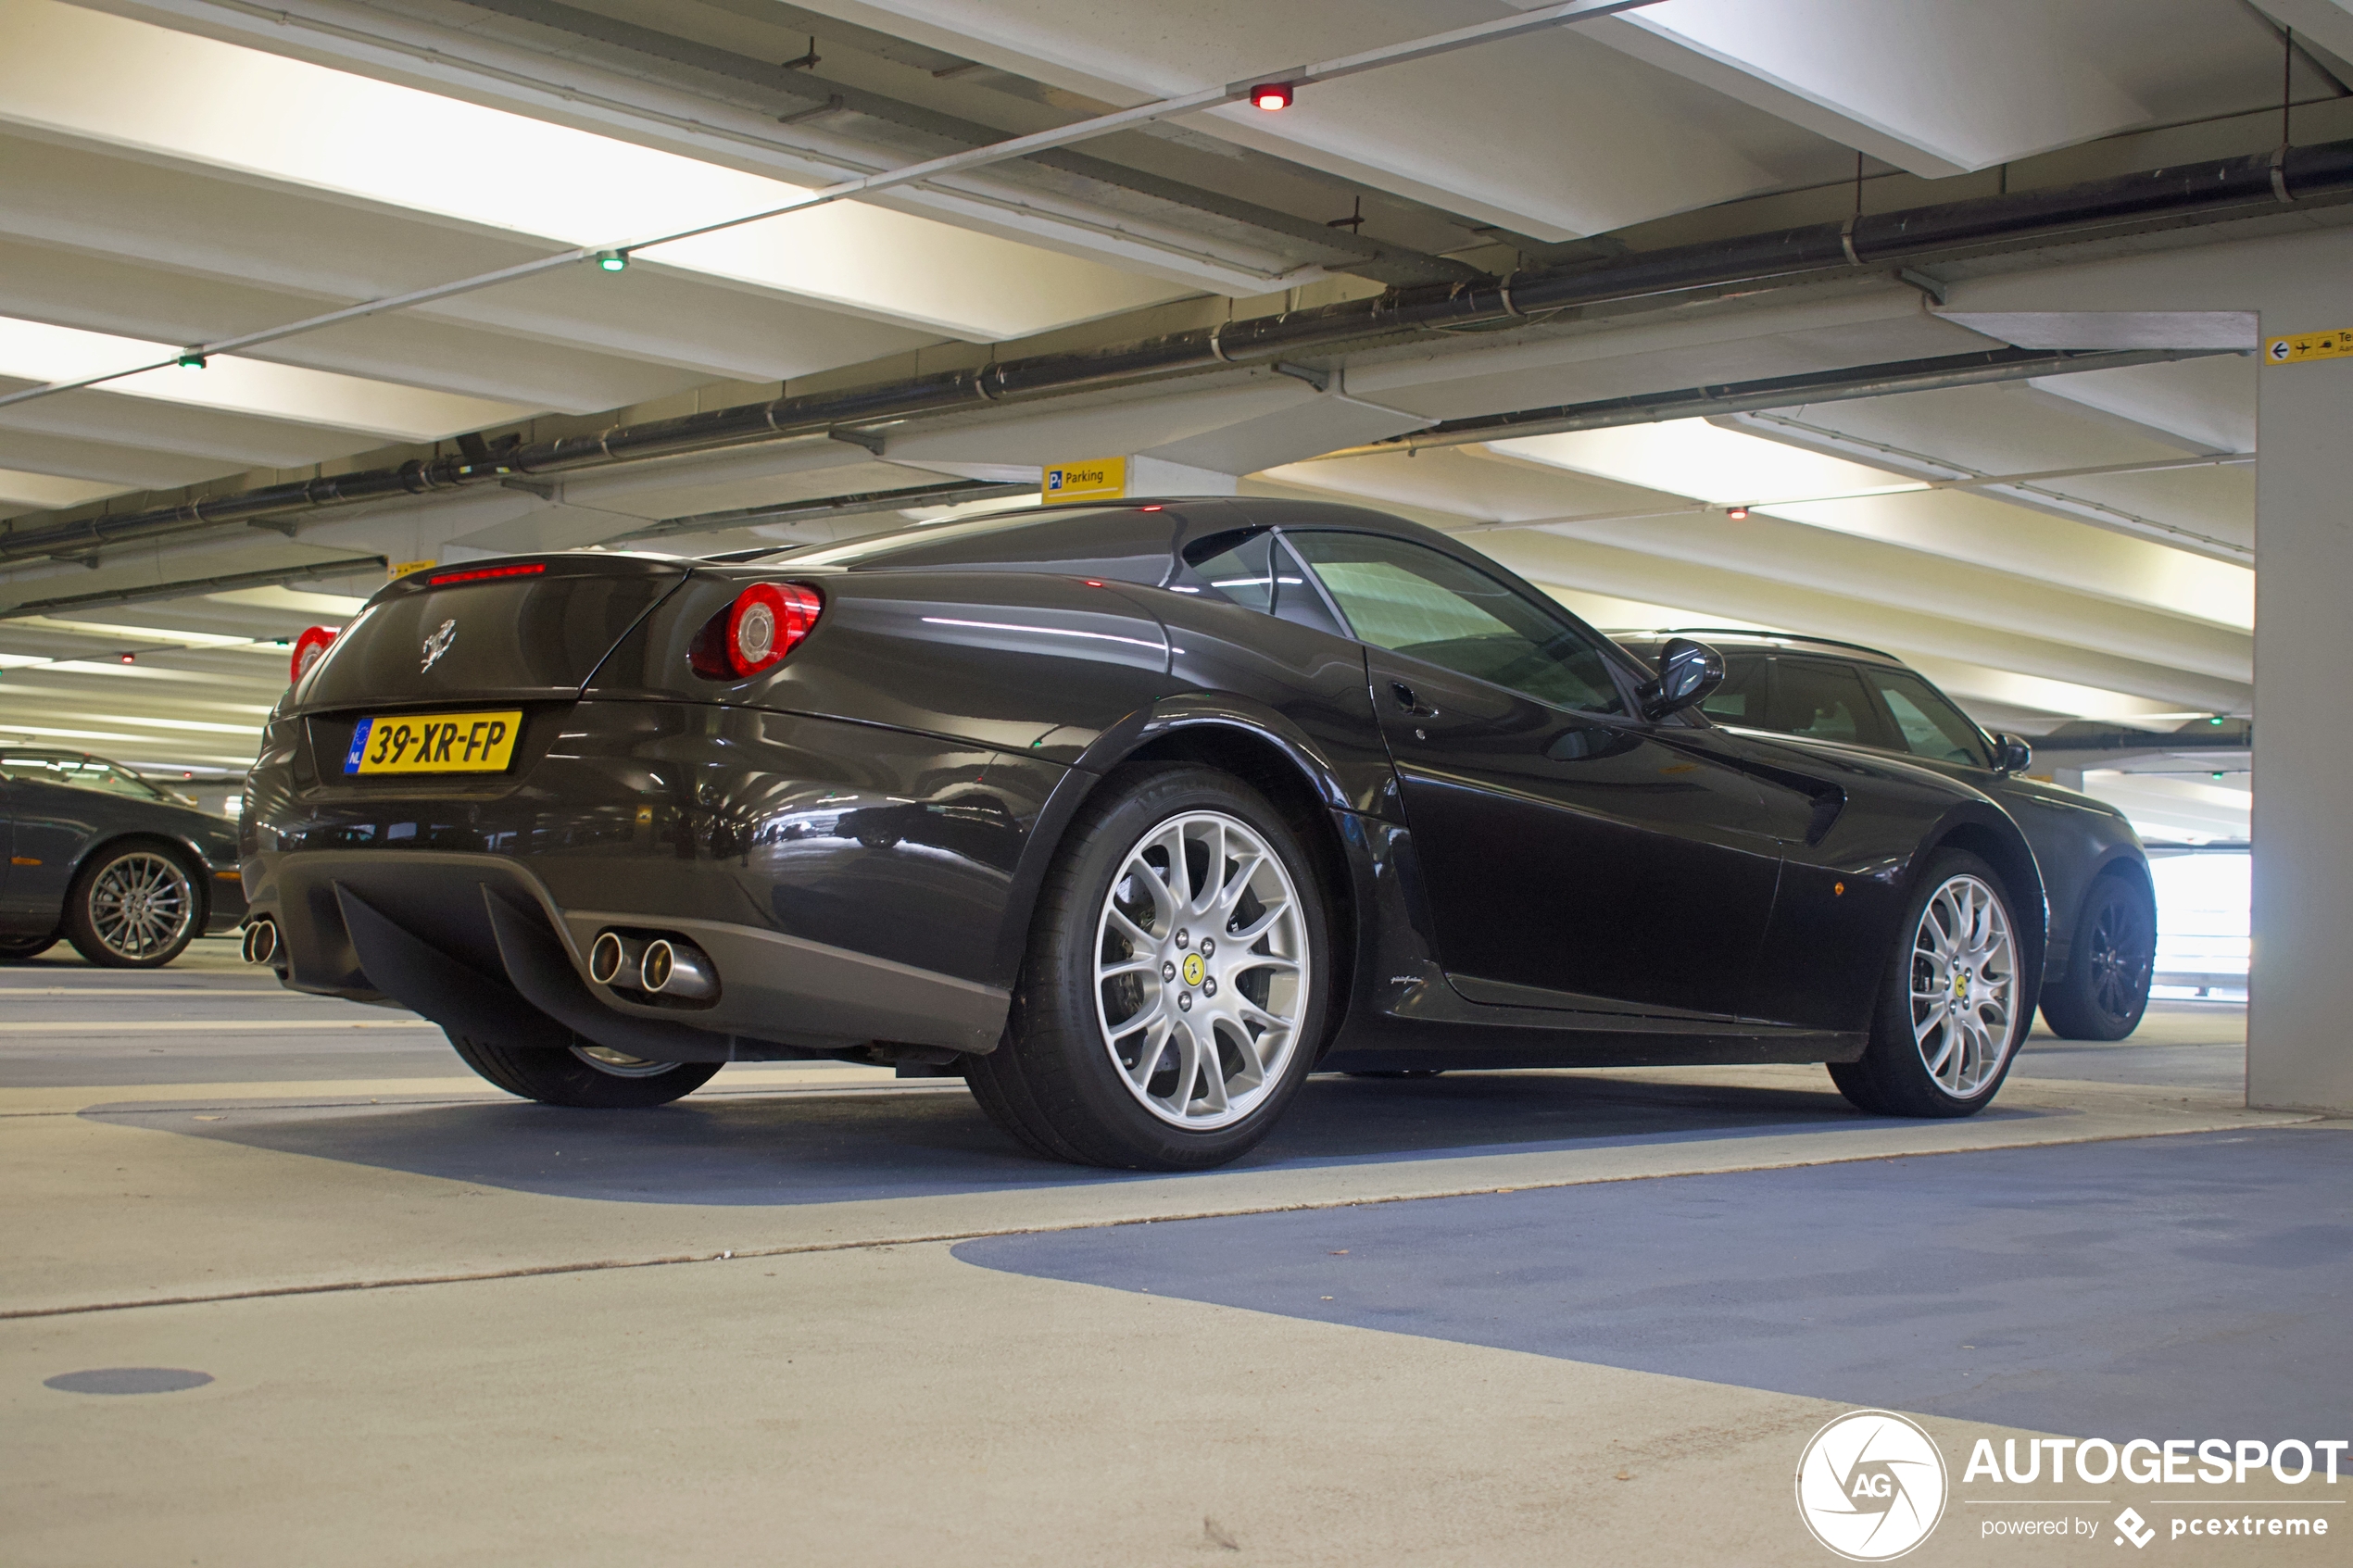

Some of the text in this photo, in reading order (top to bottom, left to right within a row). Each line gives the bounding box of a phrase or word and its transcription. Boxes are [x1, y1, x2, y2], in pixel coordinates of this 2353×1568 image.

[2338, 332, 2353, 343] Te
[1066, 470, 1103, 483] Parking
[371, 721, 507, 765] 39-XR-FP
[348, 751, 360, 765] NL
